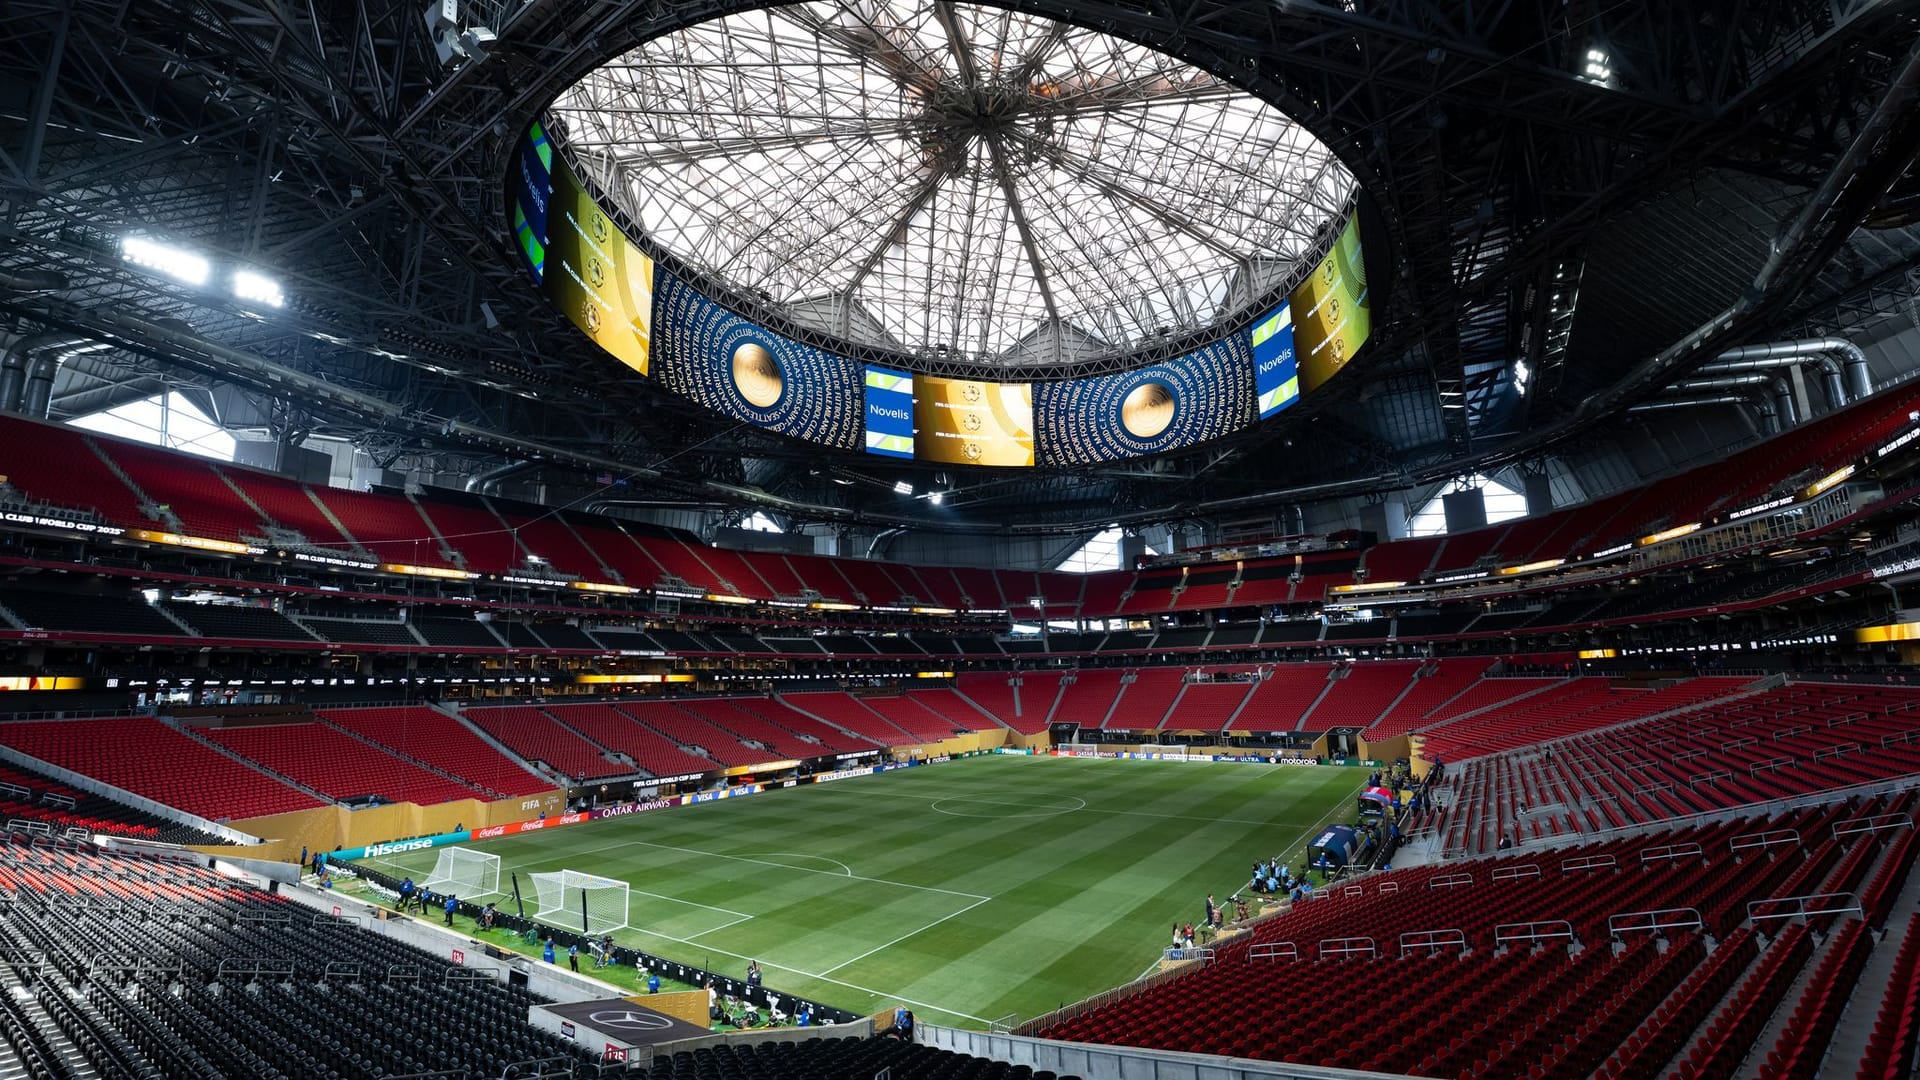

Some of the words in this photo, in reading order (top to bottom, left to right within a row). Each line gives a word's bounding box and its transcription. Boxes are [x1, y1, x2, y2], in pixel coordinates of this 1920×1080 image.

[677, 298, 687, 320] CLUB
[692, 321, 703, 368] FOOTBALL
[698, 303, 712, 323] CLUB
[713, 317, 738, 350] SOCIEDADE
[736, 328, 753, 337] CLUB
[756, 331, 778, 350] SPORT
[683, 341, 694, 386] SPORTIVE
[702, 330, 712, 385] MAMELODI
[721, 332, 737, 372] FOOTBALL
[776, 349, 792, 377] LISBOA
[1217, 346, 1228, 364] CLUB
[1224, 363, 1232, 374] DE
[1260, 348, 1291, 374] Novelis
[666, 360, 676, 386] CLUB
[676, 366, 687, 394] BOCA
[775, 335, 800, 378] PALMEIRAS
[796, 384, 804, 406] PARIS
[796, 350, 813, 409] MANCHESTER
[808, 355, 821, 382] MIAMI
[815, 350, 832, 406] ERNAZIONALE
[828, 358, 838, 381] CLUB
[1143, 371, 1165, 379] SPORT
[713, 372, 732, 410] MADRID
[1082, 382, 1095, 400] CLUB
[1099, 375, 1125, 412] SOCIEDADE
[1122, 375, 1140, 390] CLUB
[1164, 362, 1194, 388] PALMEIRAS
[1189, 391, 1197, 412] PARIS
[1165, 371, 1182, 393] LISBOA
[1185, 360, 1206, 410] MANCHESTER
[1197, 357, 1212, 378] MIAMI
[1208, 382, 1216, 417] FUTEBOL
[1203, 347, 1226, 394] ERNAZIONALE
[1215, 394, 1225, 427] MILANO
[1235, 364, 1244, 410] BOTAFOGO
[722, 373, 750, 416] SOUNDERS
[780, 383, 794, 414] BENFICA
[1060, 392, 1069, 410] CLUB
[750, 412, 780, 422] SEATTLE
[799, 409, 810, 428] CITY
[870, 404, 909, 420] Novelis
[1079, 400, 1088, 437] FOOTBALL
[1109, 389, 1125, 426] FOOTBALL
[1174, 398, 1187, 430] BENFICA
[1089, 402, 1102, 444] MAMELODI
[1194, 411, 1205, 432] CITY
[1102, 430, 1125, 454] MADRID
[1112, 425, 1144, 450] SOUNDERS
[1144, 430, 1176, 450] SEATTLE
[1052, 443, 1064, 461] CLUB
[1064, 444, 1078, 463] BOCA
[5, 513, 34, 523] CLUB
[38, 518, 75, 528] WORLD
[76, 523, 96, 531] CUP
[327, 558, 347, 566] WORLD
[1281, 758, 1317, 766] motorola
[660, 776, 678, 785] WORLD
[820, 773, 834, 781] BANK
[697, 793, 713, 802] VISA
[734, 788, 749, 796] VISA
[522, 800, 540, 811] FIFA
[602, 806, 632, 818] QATAR
[635, 799, 671, 813] AIRWAYS
[480, 826, 505, 838] Coca-Cola
[364, 839, 432, 858] Hisense
[453, 952, 462, 964] 136
